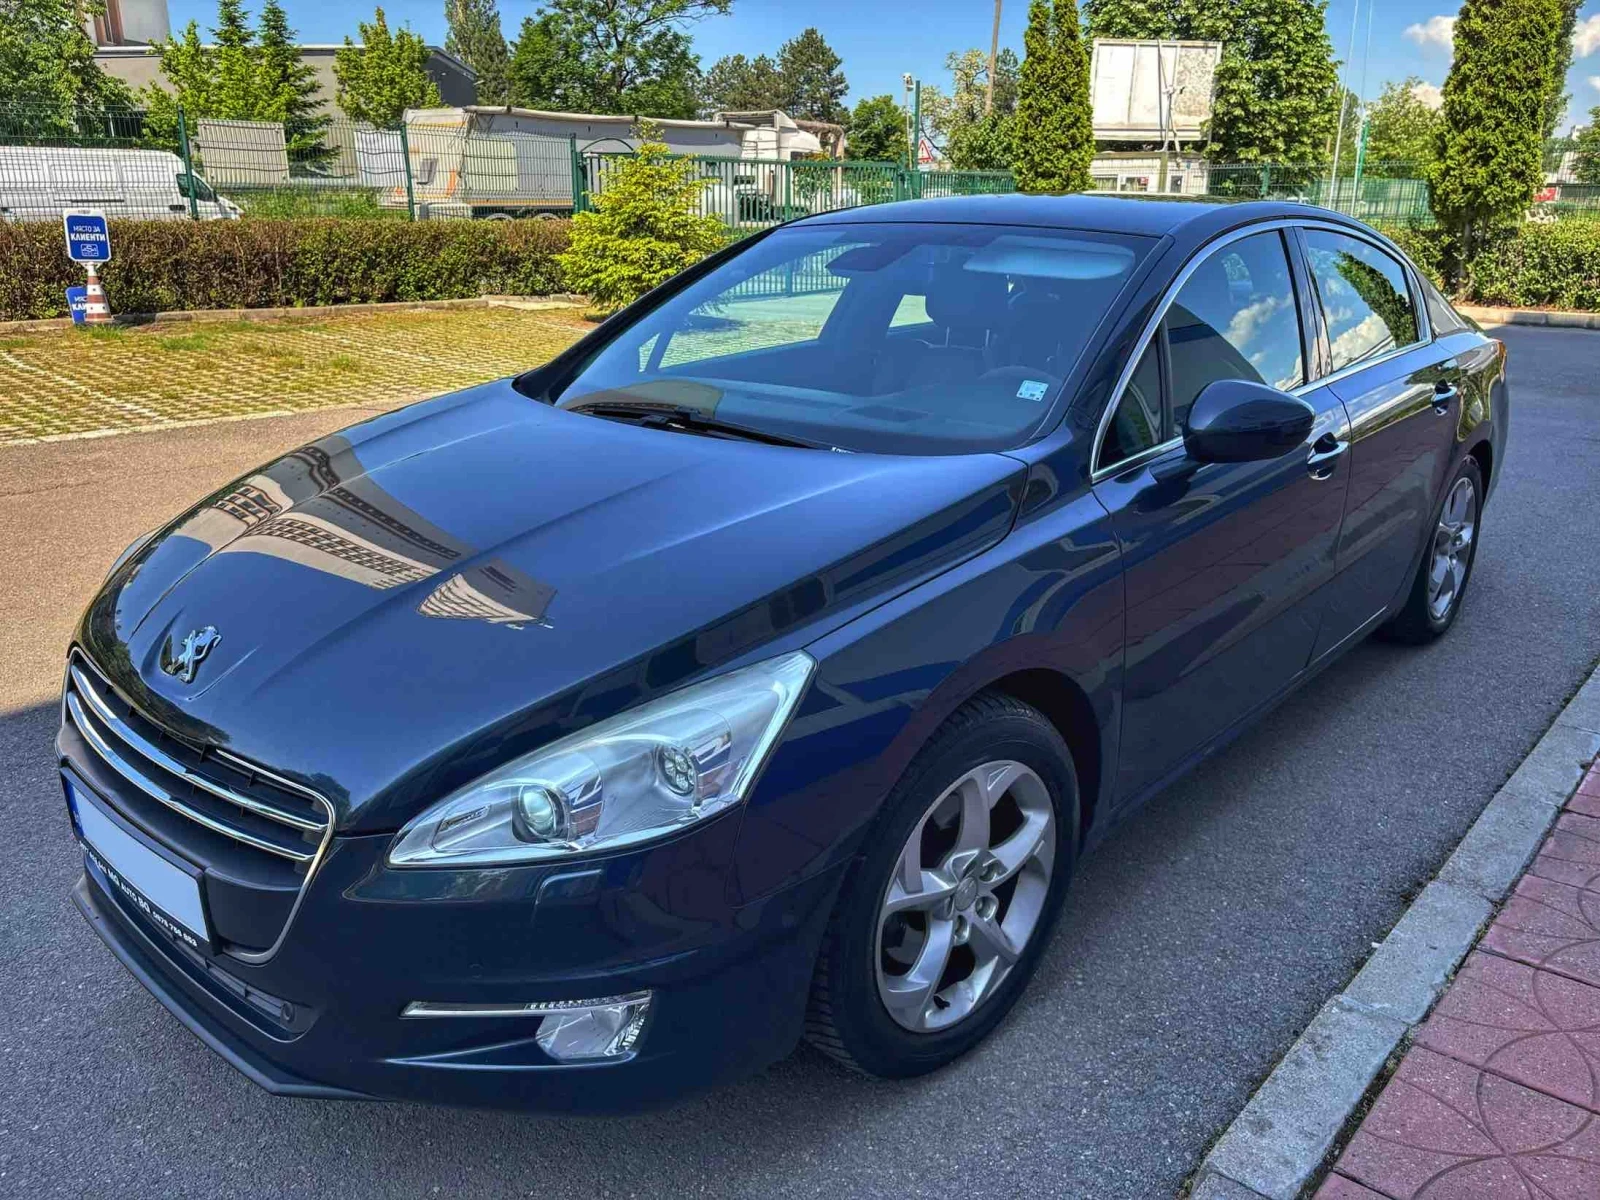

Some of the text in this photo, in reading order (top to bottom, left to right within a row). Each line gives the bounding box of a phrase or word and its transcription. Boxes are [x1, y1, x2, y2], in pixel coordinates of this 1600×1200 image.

[73, 225, 92, 233] МЯСТО
[70, 232, 106, 242] КЛИЕНТИ
[121, 881, 138, 902] AUTO
